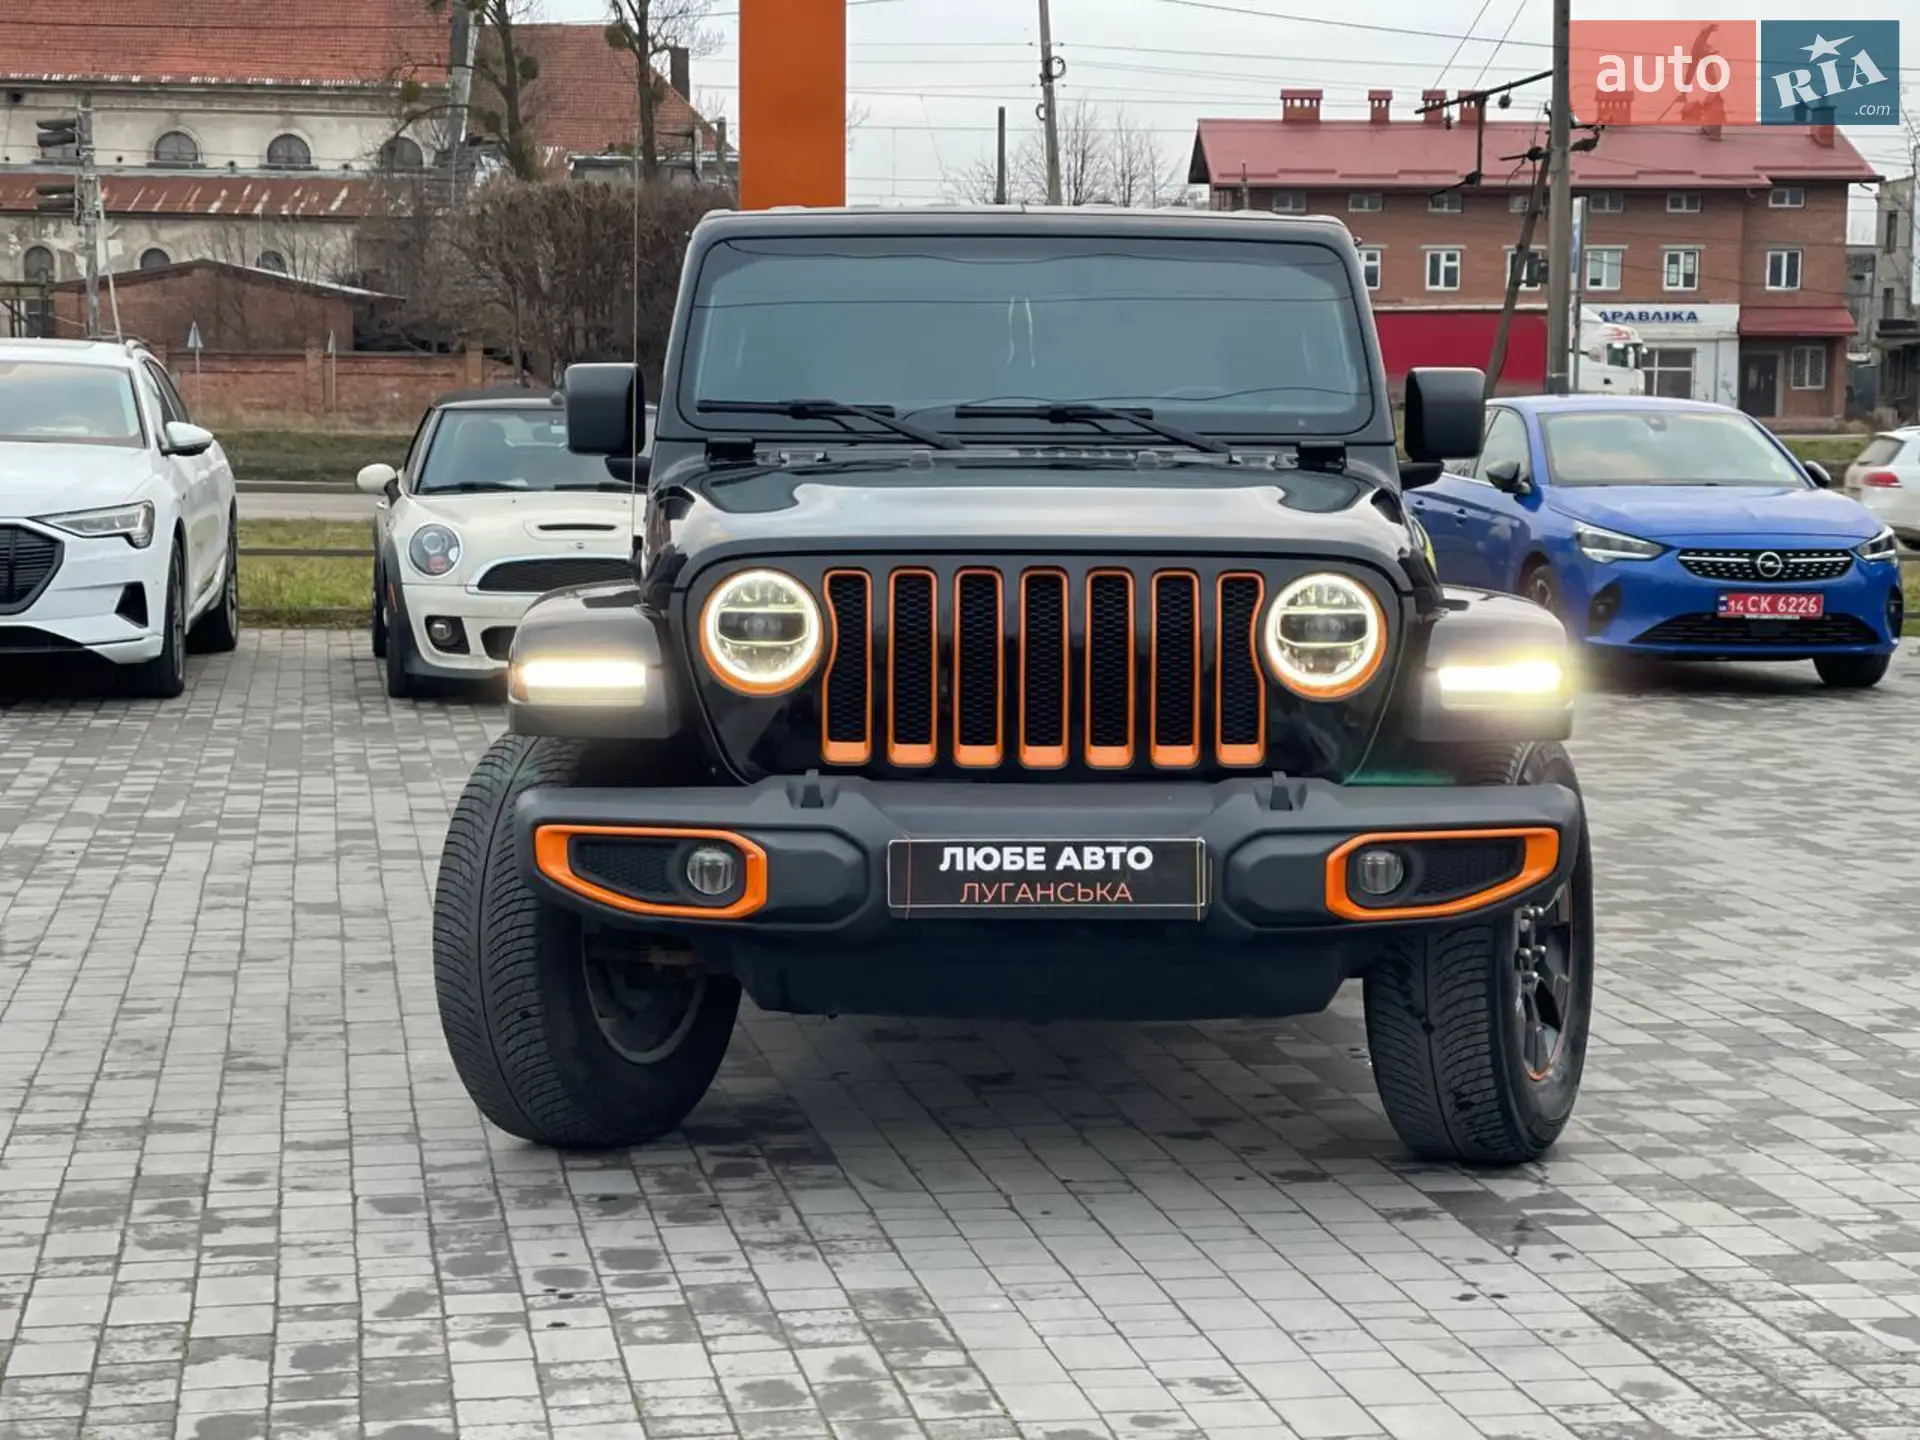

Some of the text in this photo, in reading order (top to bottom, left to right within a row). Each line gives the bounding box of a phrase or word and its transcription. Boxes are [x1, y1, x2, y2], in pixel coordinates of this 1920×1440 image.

[1777, 596, 1818, 613] 6226
[939, 845, 1154, 871] ЛЮБЕ АВТО
[960, 881, 1133, 903] ЛУГАНСЬКА
